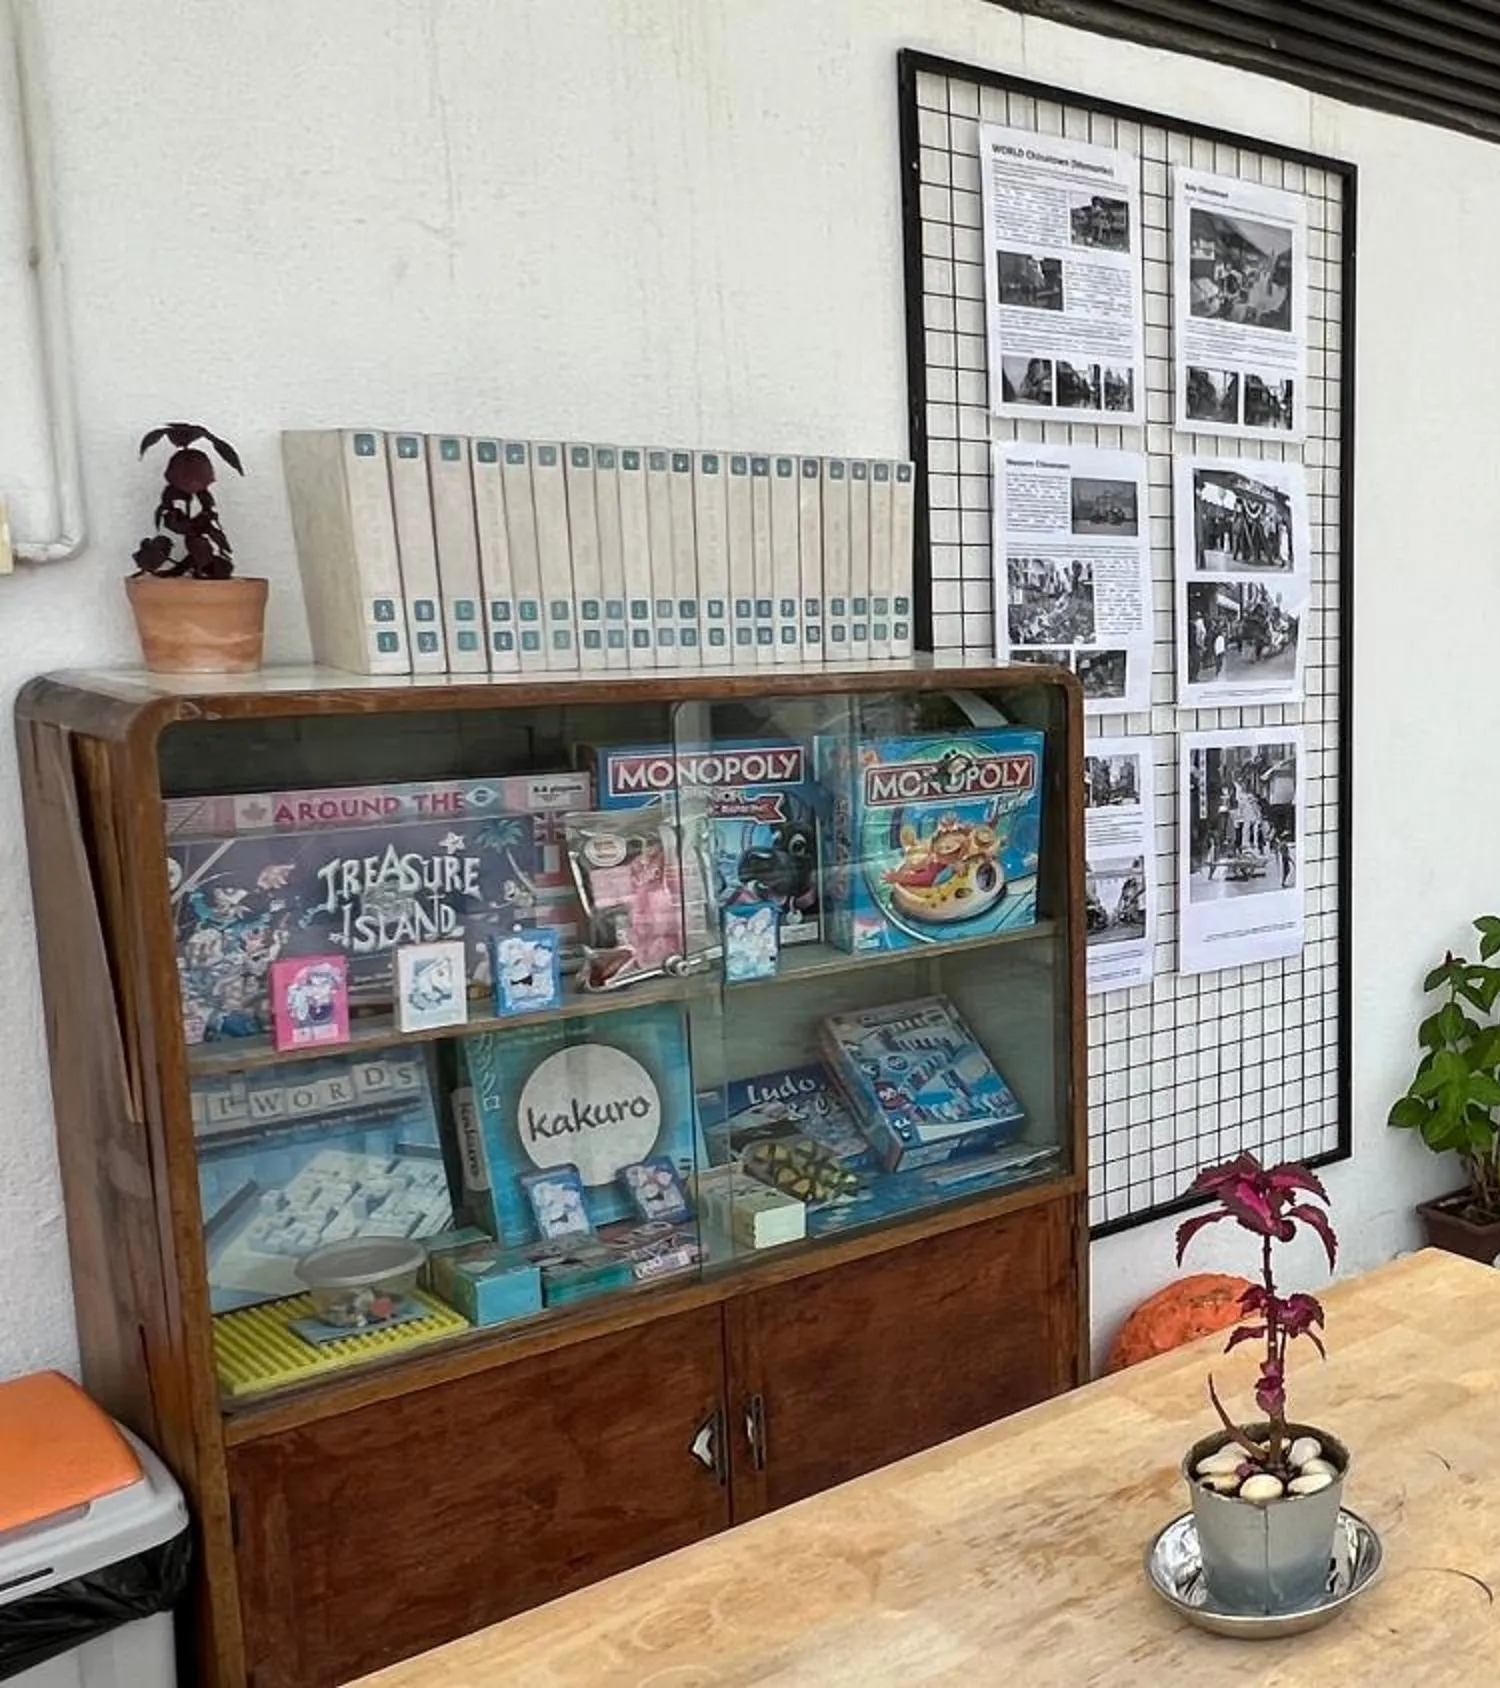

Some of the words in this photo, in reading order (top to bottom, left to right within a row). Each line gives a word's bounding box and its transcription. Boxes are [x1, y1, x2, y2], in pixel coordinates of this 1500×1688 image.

[991, 144, 1025, 158] WORLD
[616, 753, 799, 791] MONOPOLY
[274, 797, 400, 824] AROUND
[411, 791, 466, 815] THE
[317, 845, 482, 906] TREASURE
[339, 902, 465, 950] ISLAND
[526, 1091, 652, 1143] kakuro
